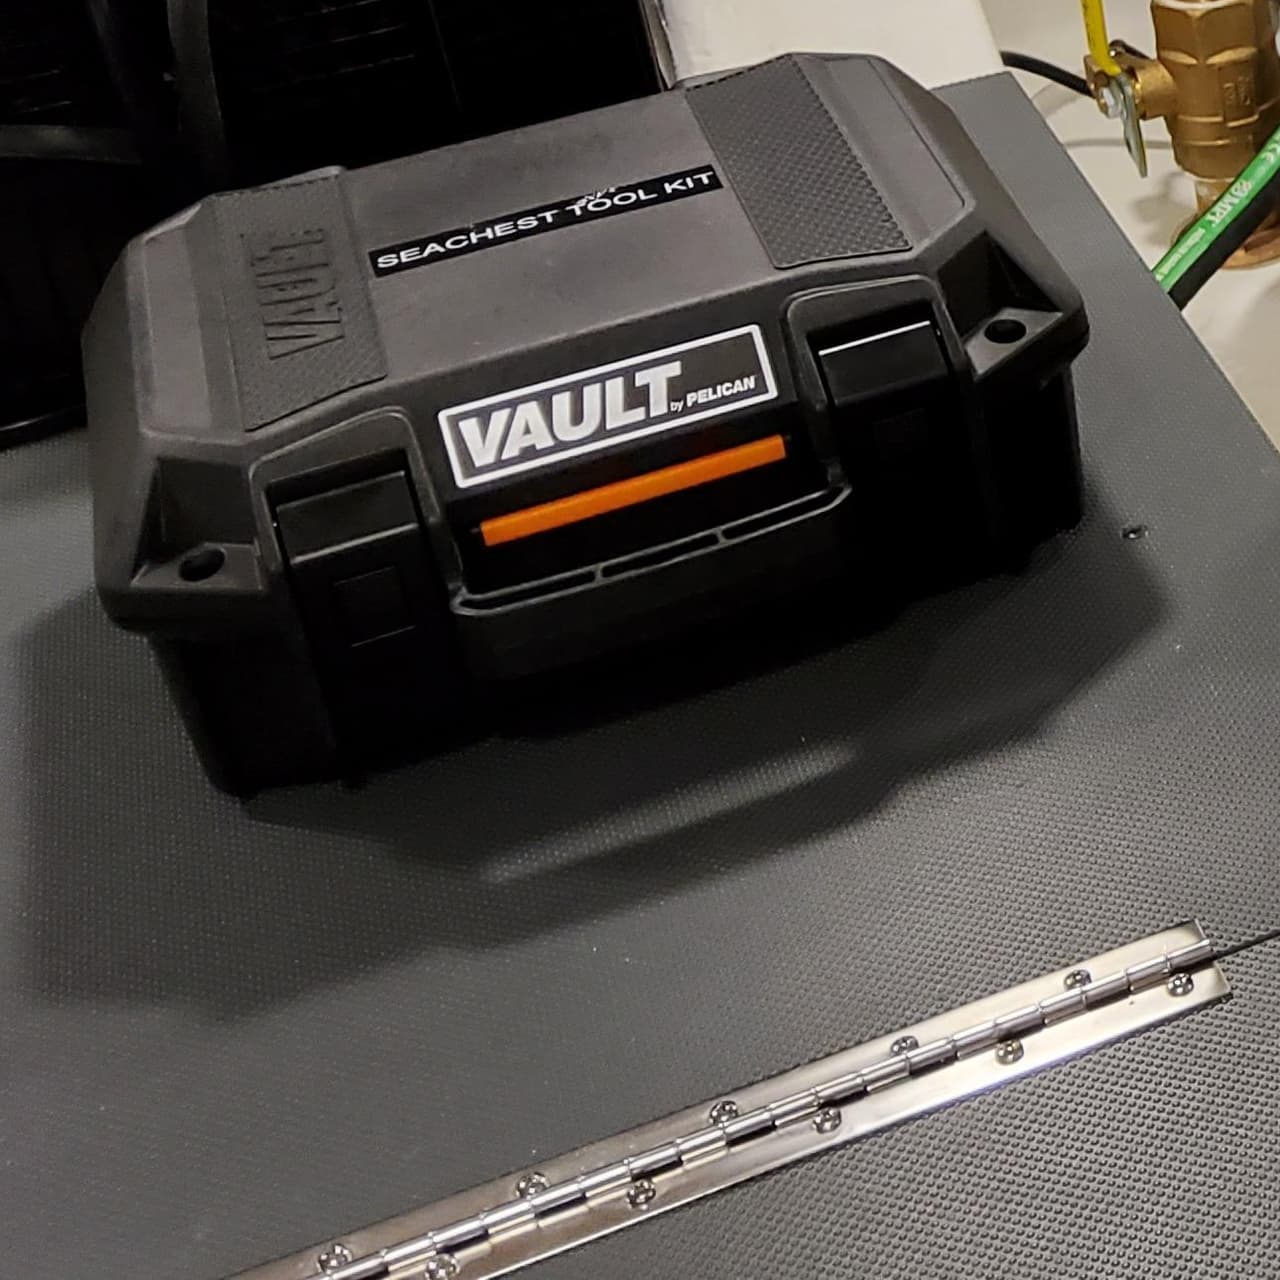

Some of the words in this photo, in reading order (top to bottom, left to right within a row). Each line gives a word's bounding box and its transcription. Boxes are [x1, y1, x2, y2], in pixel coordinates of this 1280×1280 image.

[376, 209, 560, 269] SEACHEST
[565, 188, 658, 218] TOOL
[663, 170, 715, 195] KIT
[250, 228, 346, 361] VAULT
[458, 360, 683, 468] VAULT
[669, 400, 684, 413] by
[686, 376, 756, 408] PELICAN
